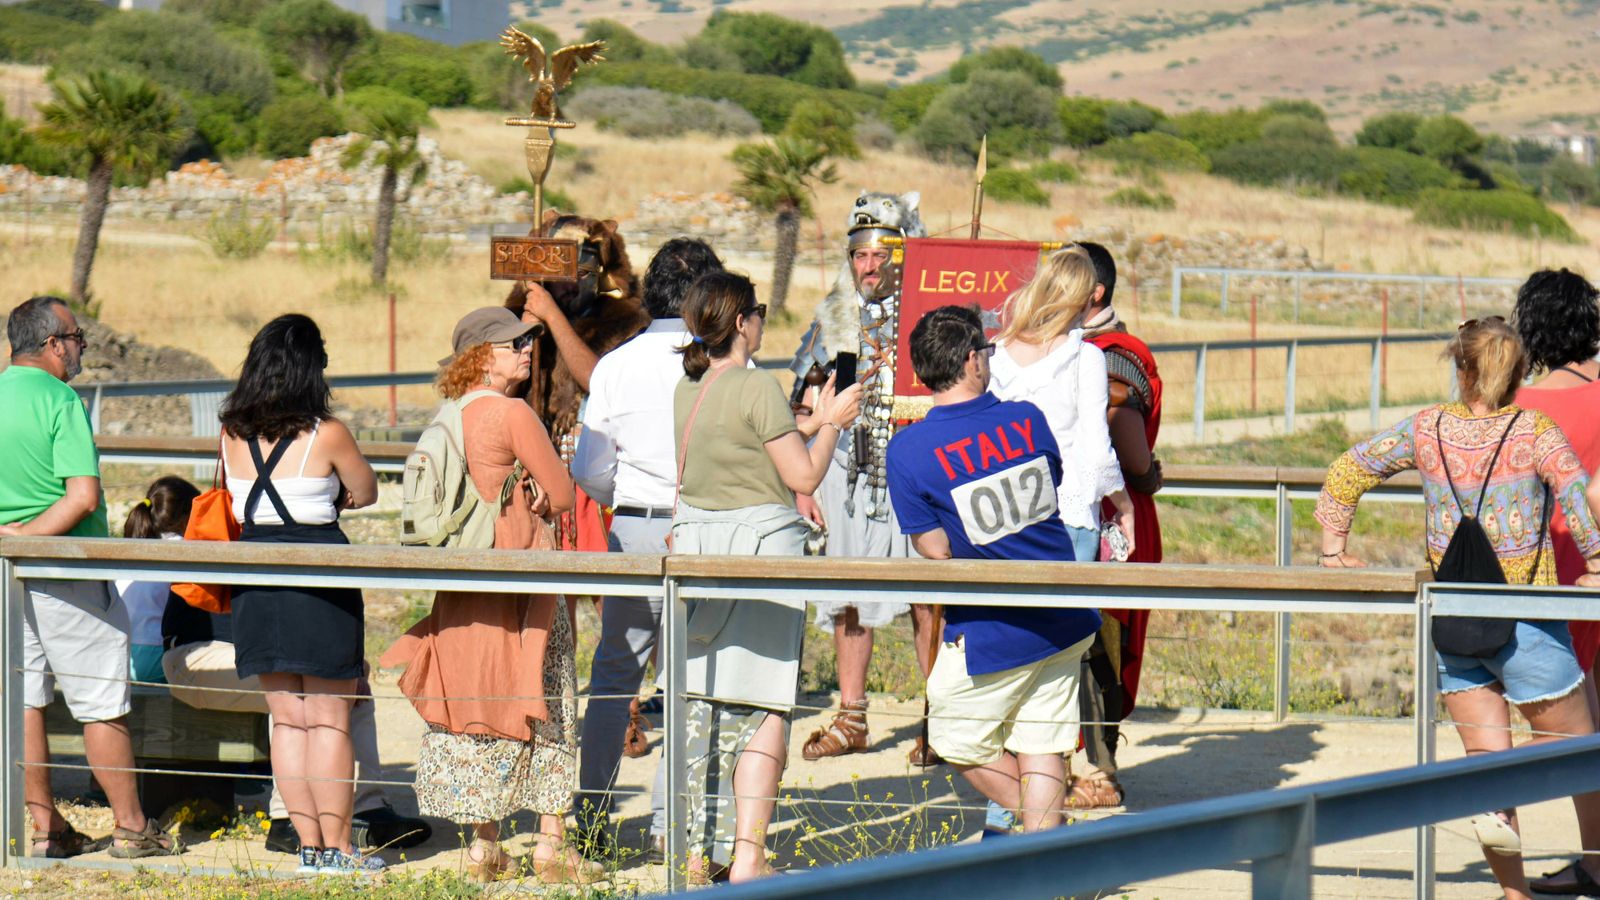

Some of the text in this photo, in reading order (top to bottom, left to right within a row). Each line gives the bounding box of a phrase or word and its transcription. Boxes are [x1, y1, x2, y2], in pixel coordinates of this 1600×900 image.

[918, 269, 1010, 293] LEG.IX
[934, 418, 1035, 480] ITALY
[970, 467, 1051, 535] 012
